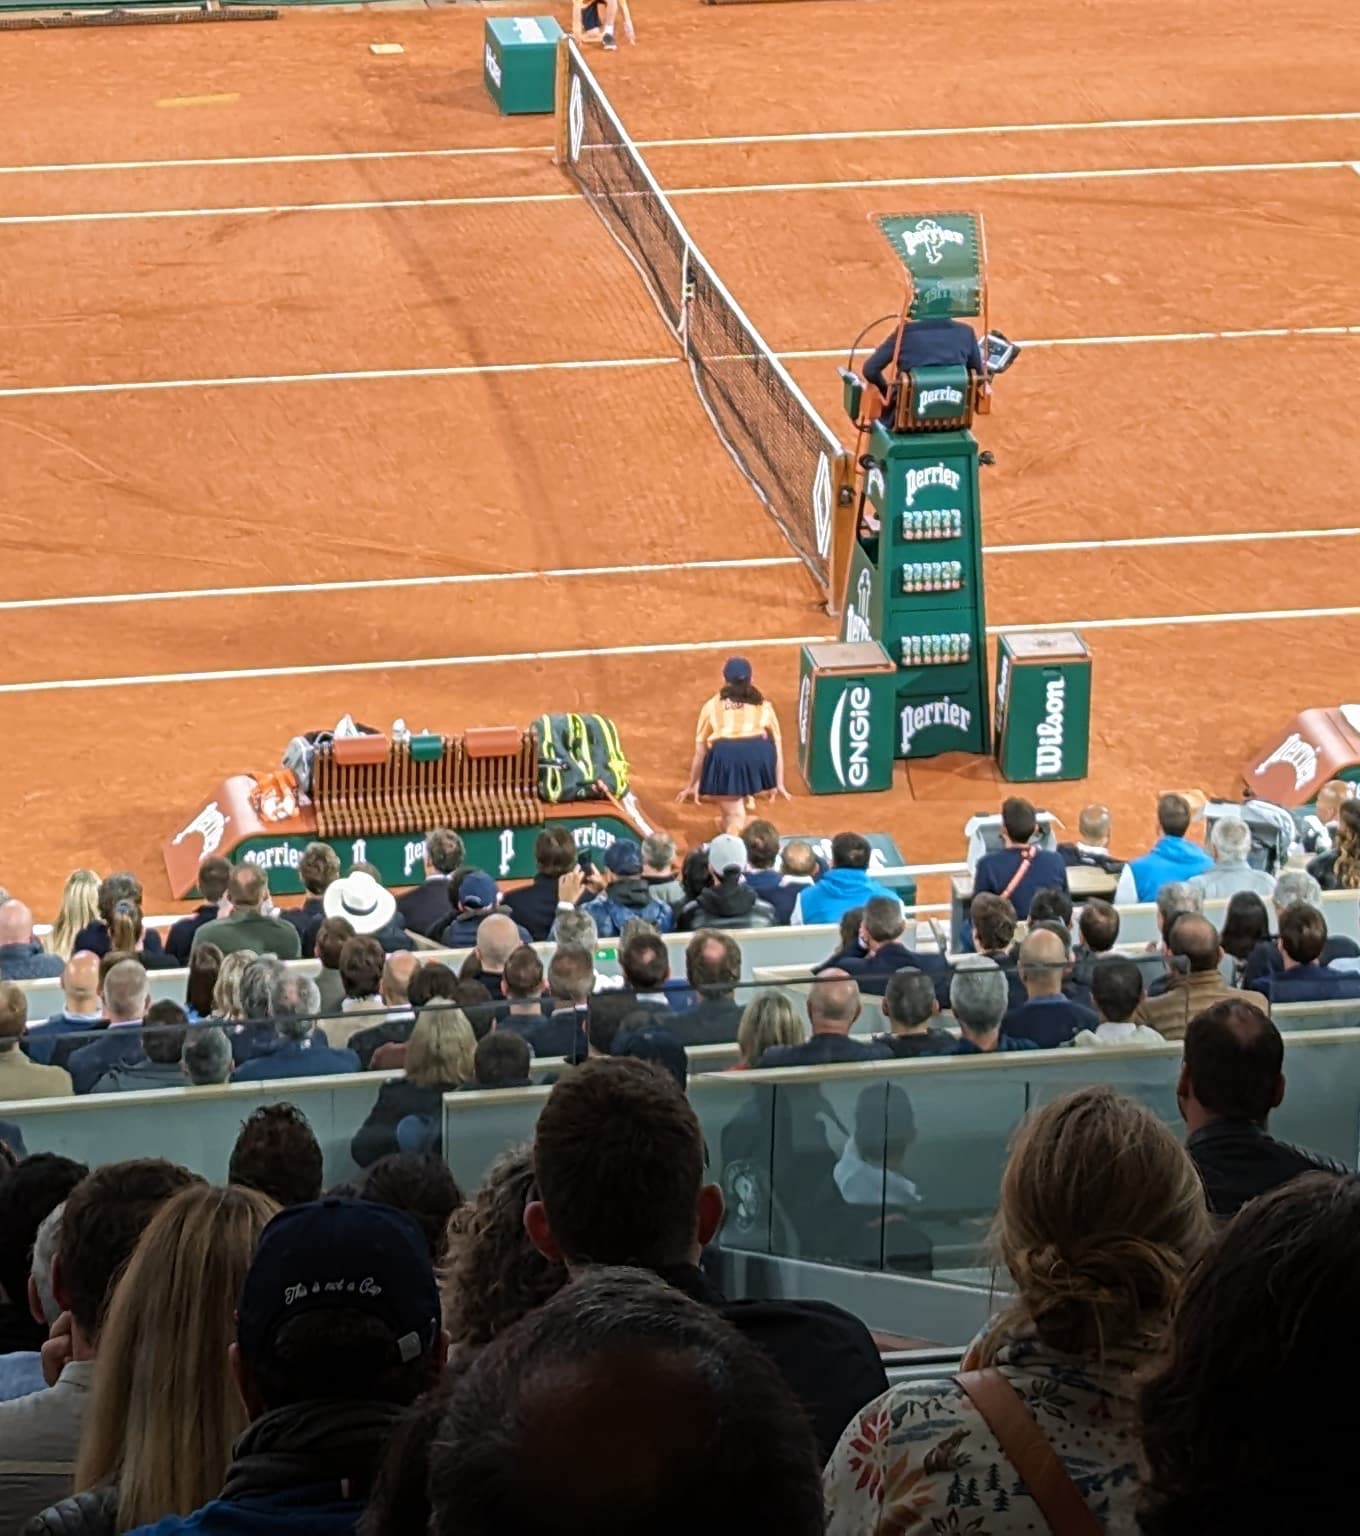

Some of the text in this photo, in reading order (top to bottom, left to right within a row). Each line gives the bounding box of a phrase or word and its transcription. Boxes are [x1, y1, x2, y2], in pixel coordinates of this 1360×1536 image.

[1035, 675, 1066, 777] Wilson
[284, 1276, 383, 1305] This is not a Cap
